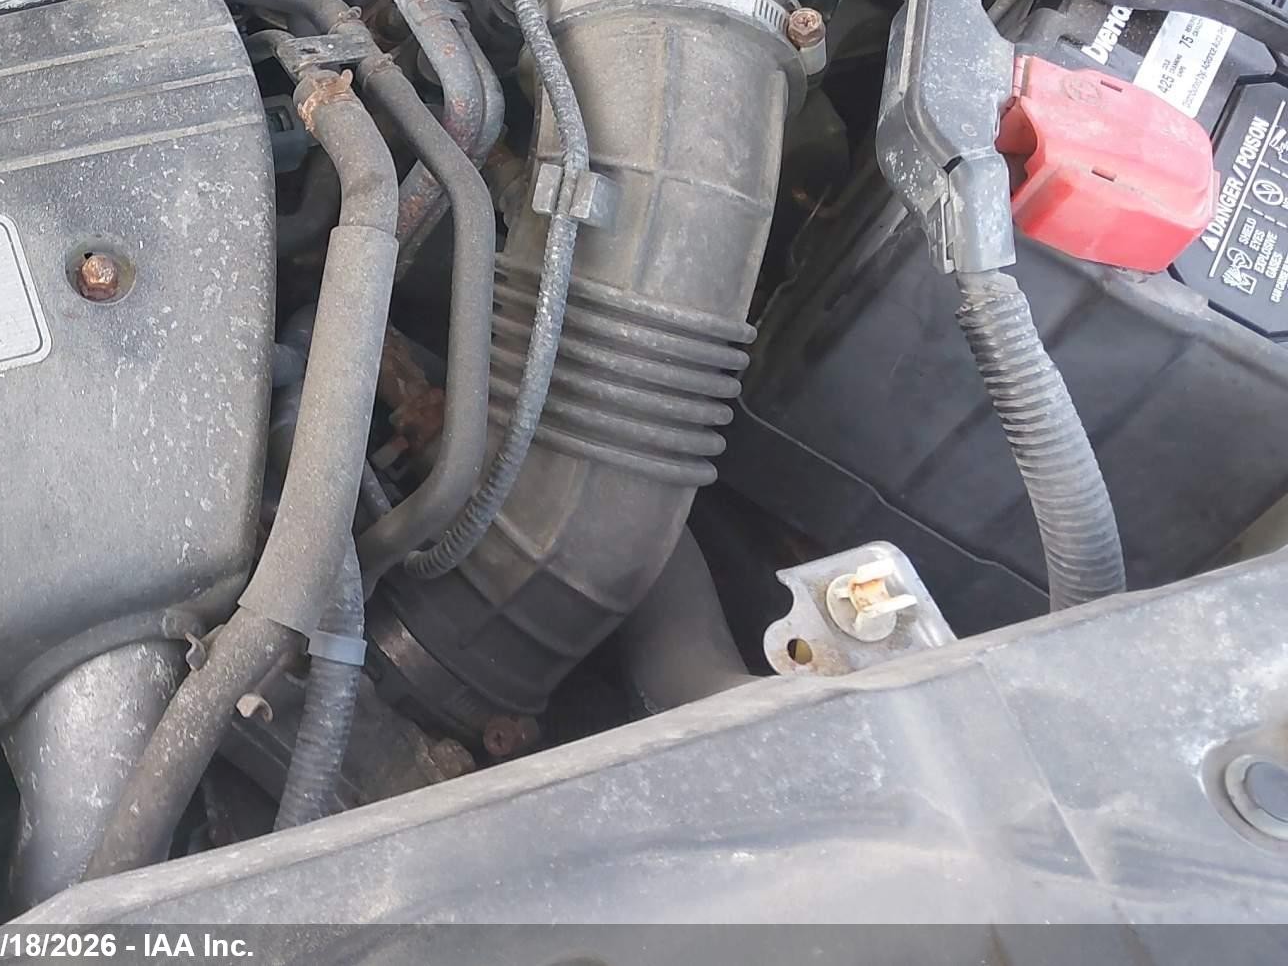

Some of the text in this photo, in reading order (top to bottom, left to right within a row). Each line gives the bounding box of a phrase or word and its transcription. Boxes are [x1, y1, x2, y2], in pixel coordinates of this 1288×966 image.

[1179, 34, 1194, 49] 75
[1157, 74, 1175, 94] 425
[1207, 176, 1243, 237] DANGER
[1236, 117, 1270, 169] POISON
[1238, 217, 1257, 245] SHIELD
[1249, 229, 1266, 251] EYES
[1254, 230, 1278, 274] EXPLOSIVE
[1265, 251, 1283, 279] GASES
